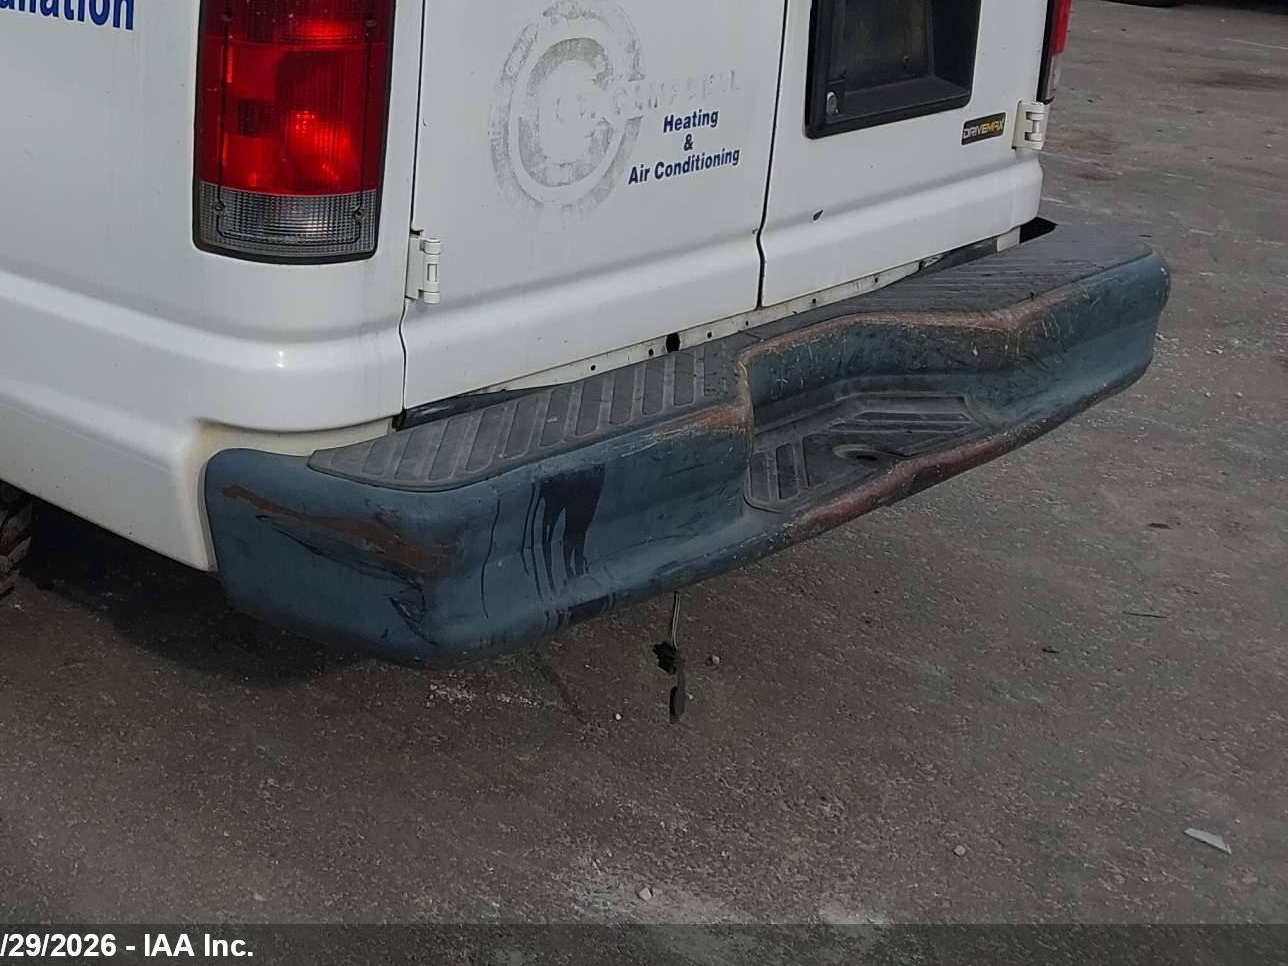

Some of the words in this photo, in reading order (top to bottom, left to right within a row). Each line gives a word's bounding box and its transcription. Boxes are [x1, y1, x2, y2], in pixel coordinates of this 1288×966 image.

[663, 108, 719, 133] Heating
[963, 116, 1005, 139] DRIVEMAX
[683, 133, 694, 152] &
[628, 164, 650, 185] Air
[654, 147, 740, 180] Conditioning
